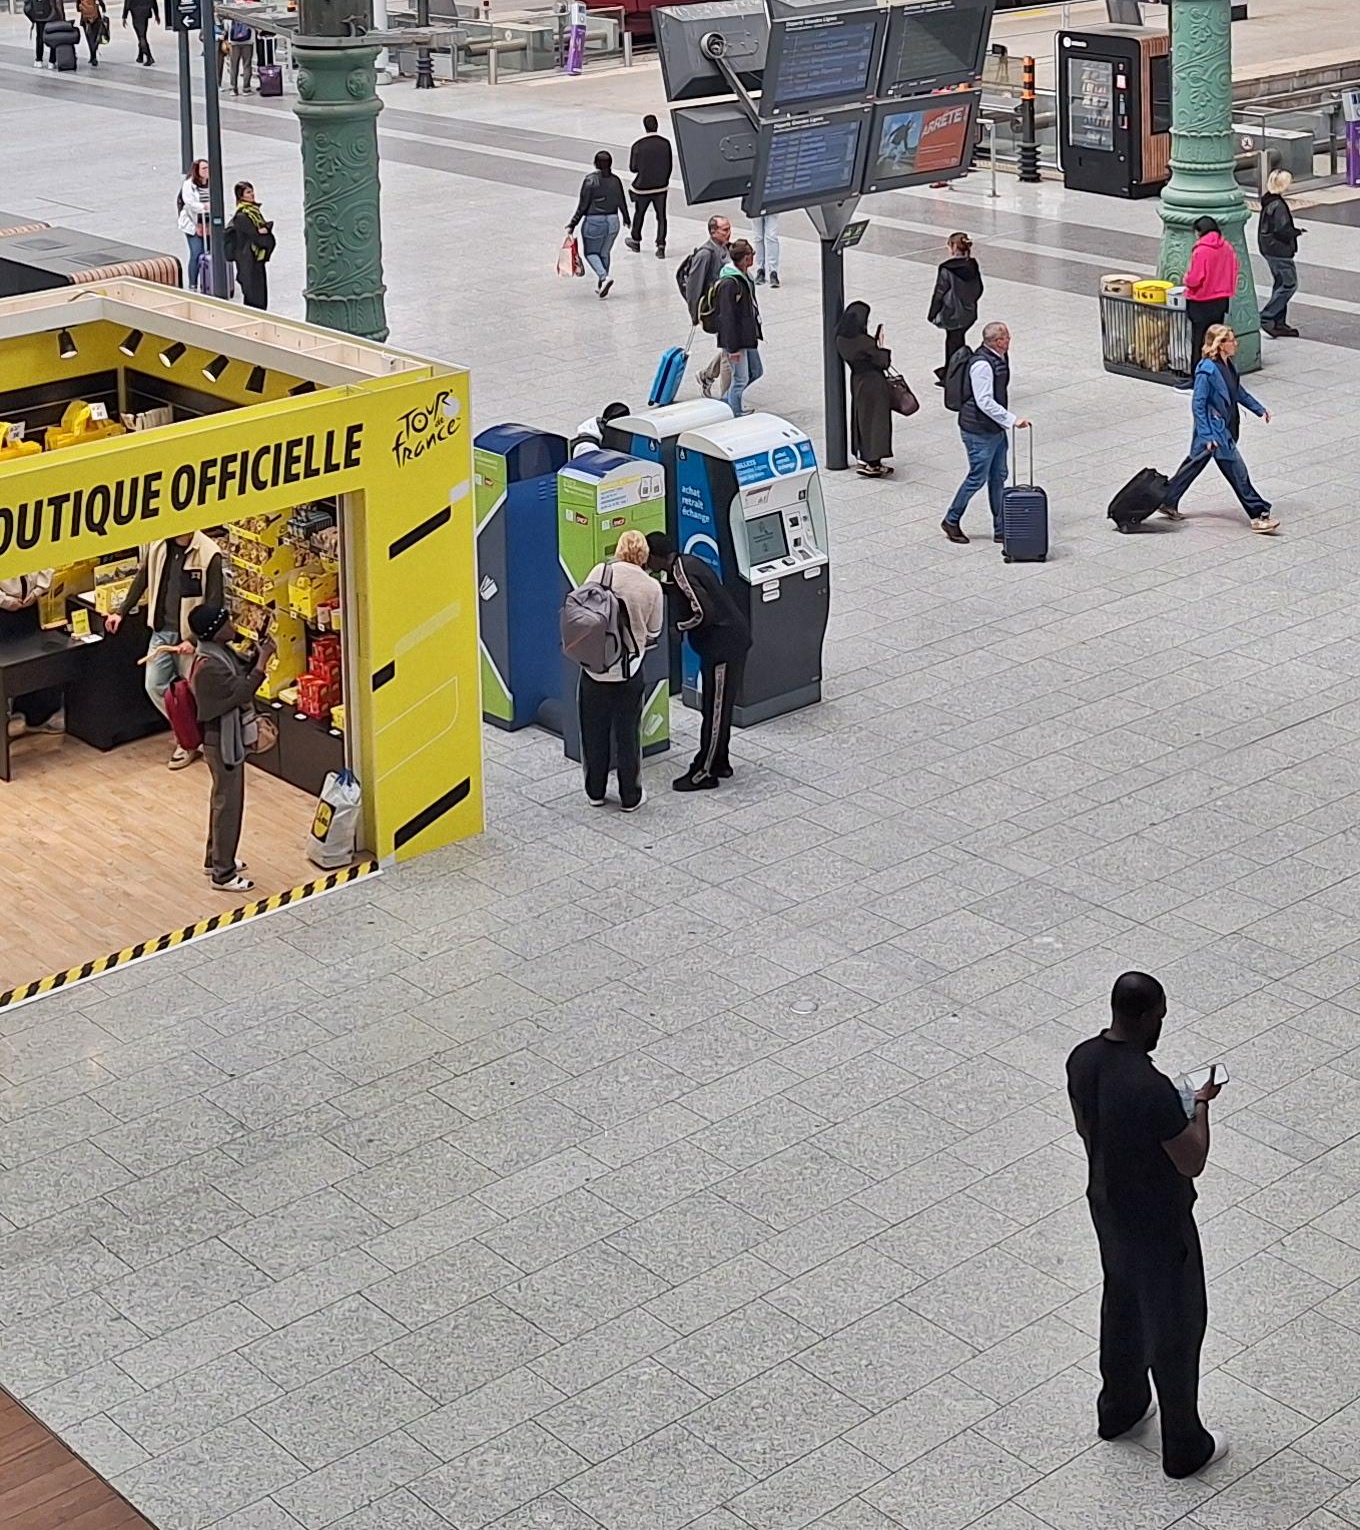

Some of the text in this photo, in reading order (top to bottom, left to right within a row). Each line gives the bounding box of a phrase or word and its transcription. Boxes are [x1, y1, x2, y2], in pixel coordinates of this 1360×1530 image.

[170, 422, 365, 511] OFFICIELLE
[681, 485, 701, 499] achat
[681, 496, 704, 511] retrait
[681, 507, 711, 524] échange
